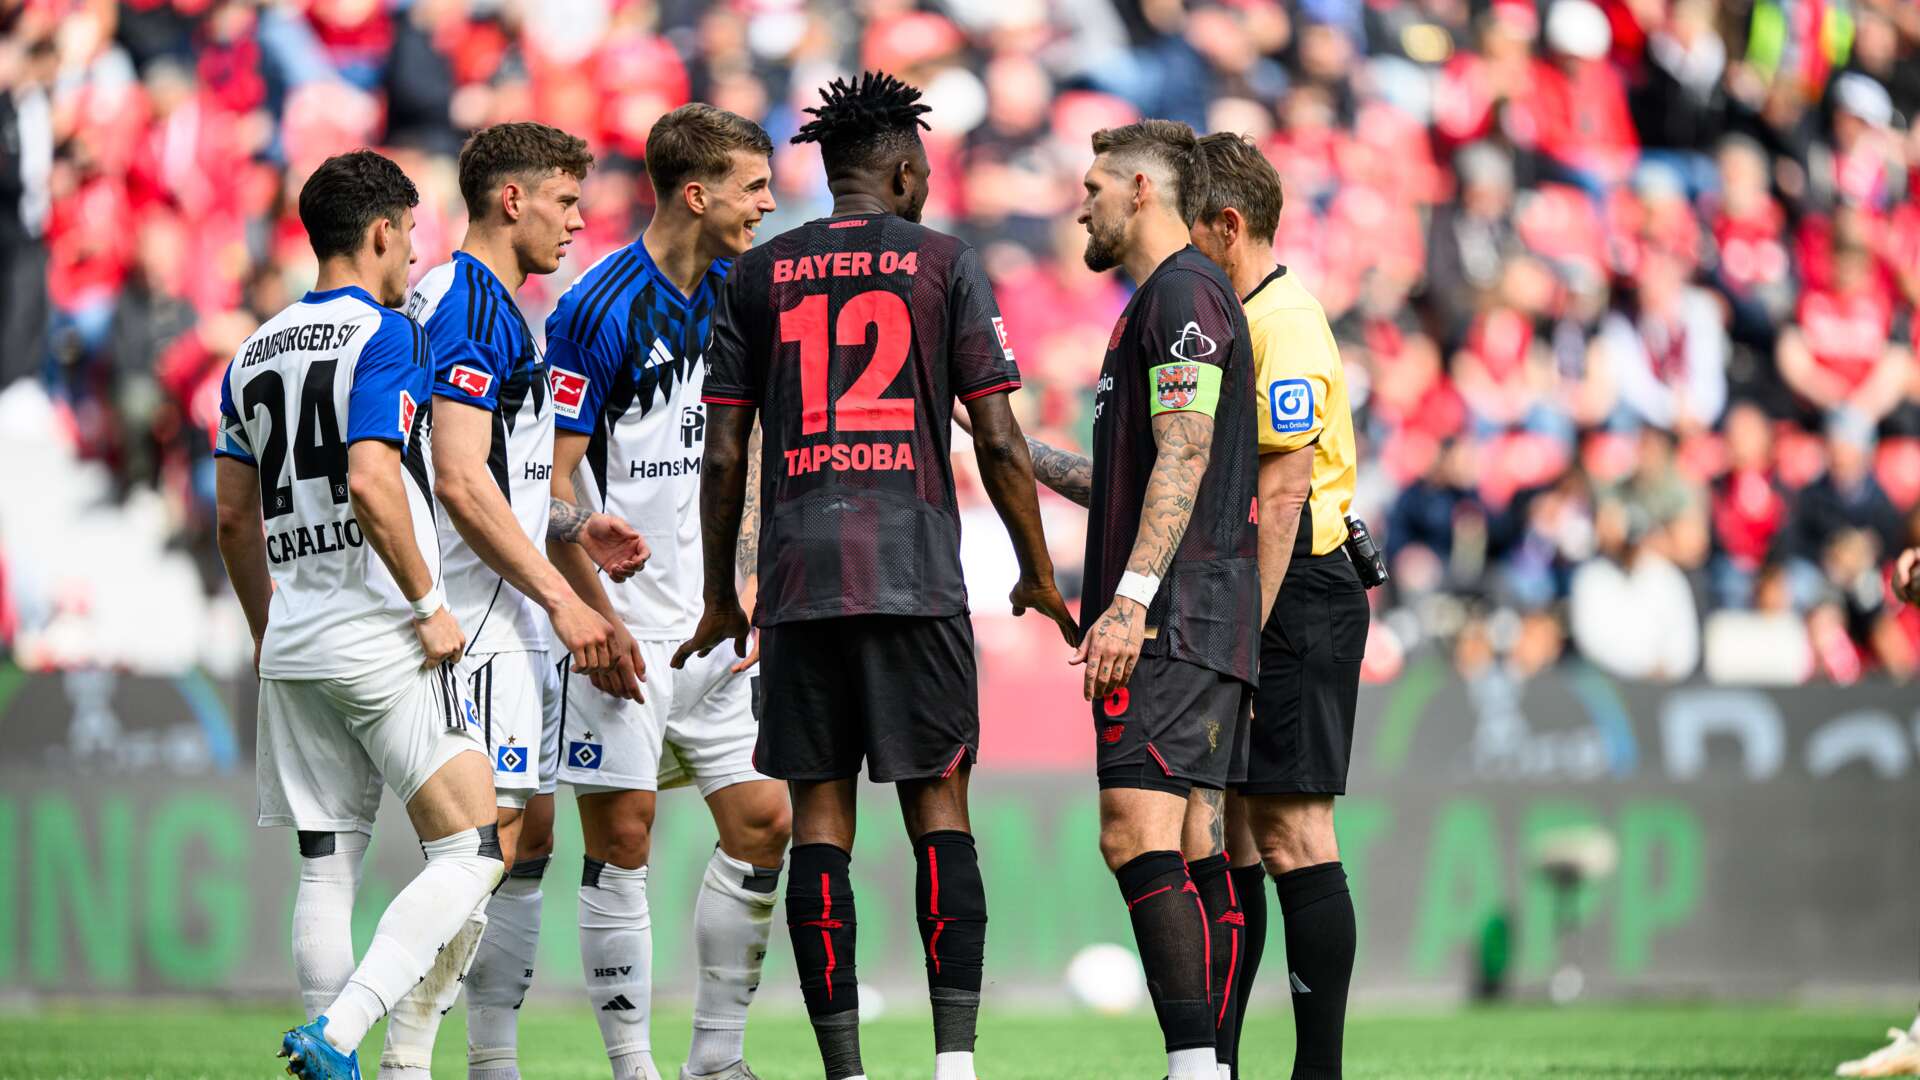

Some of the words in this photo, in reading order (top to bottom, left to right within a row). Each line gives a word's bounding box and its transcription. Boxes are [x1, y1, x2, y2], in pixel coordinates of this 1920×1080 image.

[773, 251, 872, 283] BAYER
[879, 250, 918, 276] 04
[241, 323, 335, 369] HAMBURGER
[333, 324, 361, 350] SV
[779, 290, 915, 436] 12
[242, 358, 350, 520] 24
[784, 443, 916, 477] TAPSOBA
[1411, 795, 1704, 982] APP
[593, 965, 632, 977] HSV
